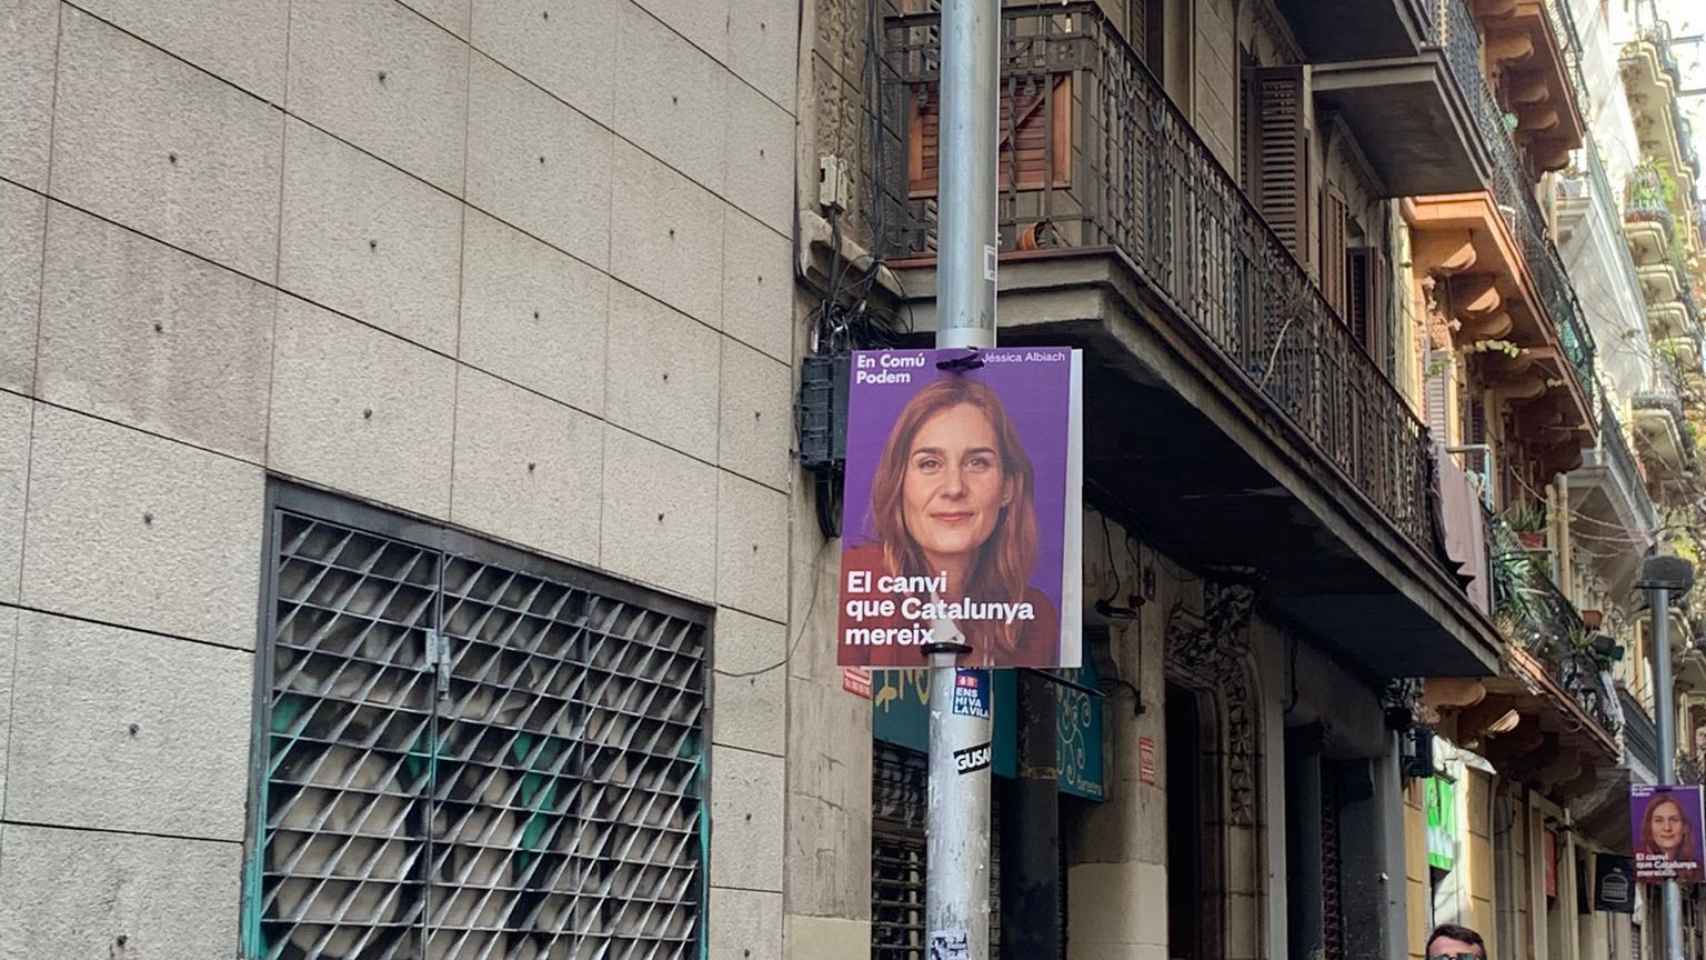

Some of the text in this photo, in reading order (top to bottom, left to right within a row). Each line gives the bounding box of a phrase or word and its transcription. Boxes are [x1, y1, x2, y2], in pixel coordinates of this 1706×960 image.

[857, 353, 925, 368] En Comú
[982, 352, 1066, 363] Jéssica Albiach
[856, 371, 911, 384] Podem
[847, 571, 947, 593] El canvi
[846, 597, 1035, 624] que Catalunya
[845, 624, 935, 646] mereix
[956, 688, 978, 698] ENS
